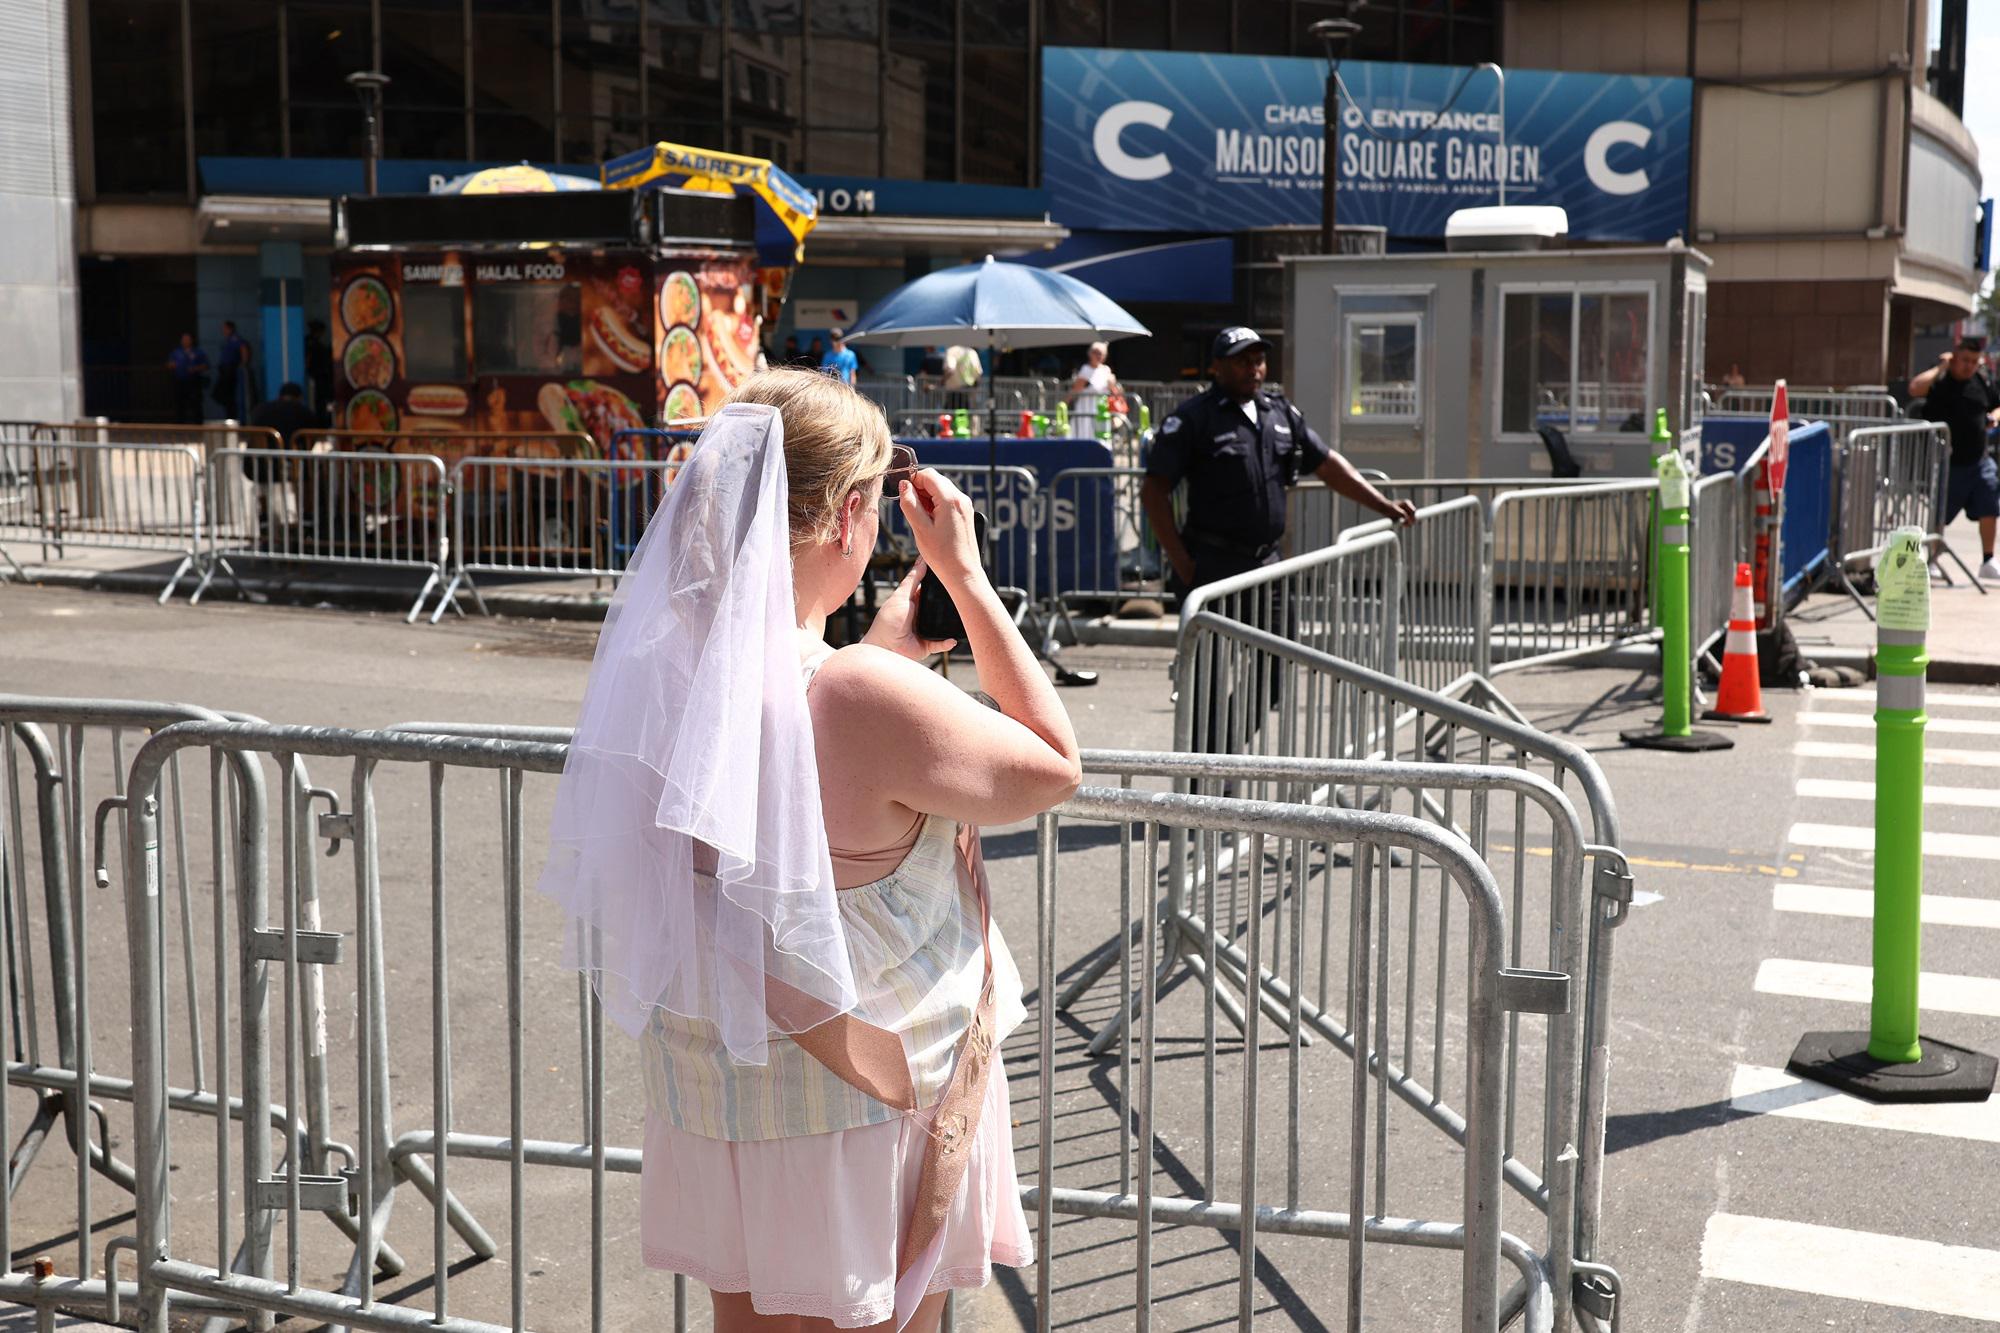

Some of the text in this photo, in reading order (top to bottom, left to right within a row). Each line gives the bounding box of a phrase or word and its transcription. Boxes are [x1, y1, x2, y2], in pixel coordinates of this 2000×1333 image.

[1265, 104, 1502, 133] CHAS ENTRANCE
[1093, 101, 1174, 180] C
[1342, 133, 1438, 180] SQUARE
[1583, 121, 1652, 195] C
[663, 150, 764, 184] SABRETT
[476, 265, 521, 281] HALAL
[525, 264, 566, 280] FOOD
